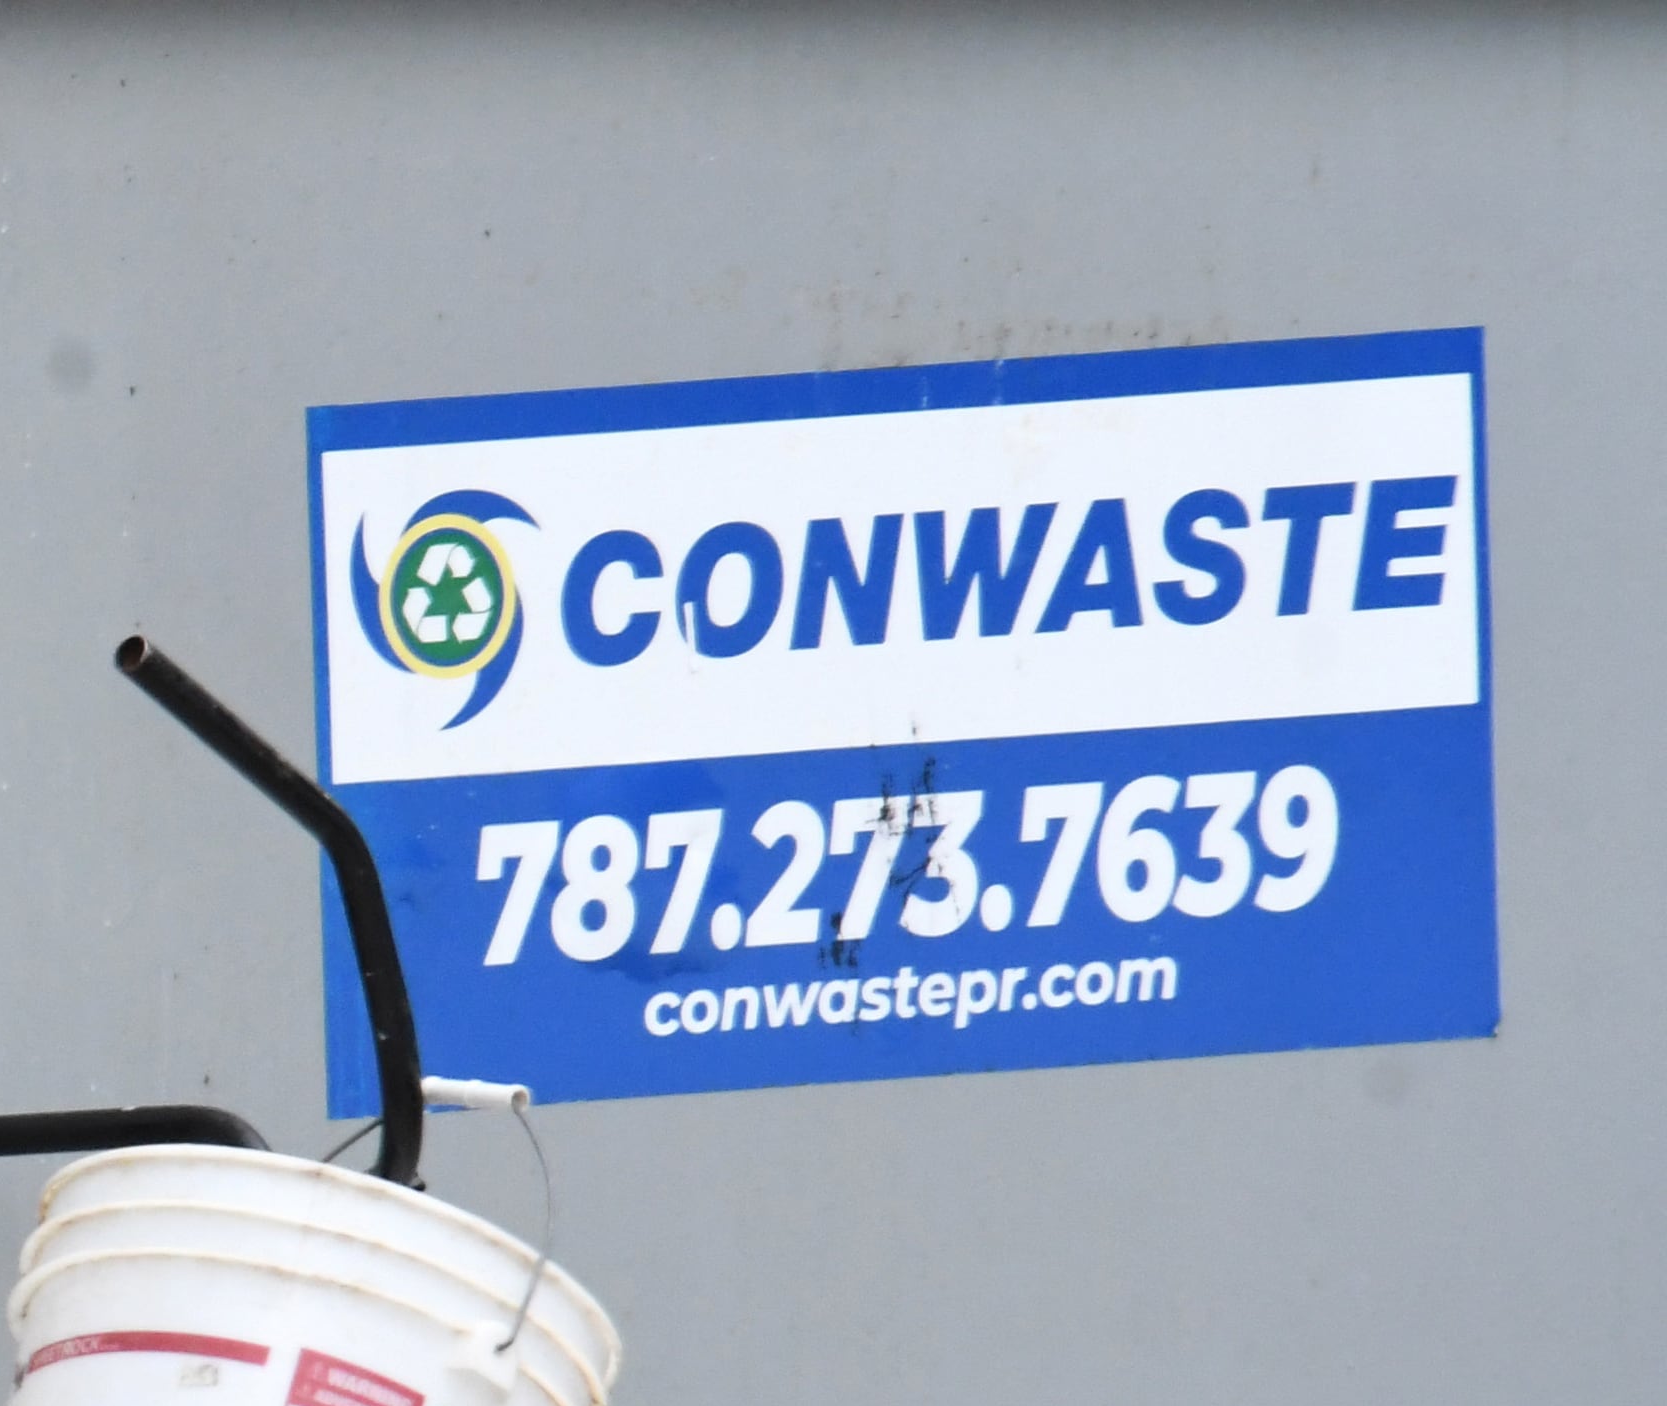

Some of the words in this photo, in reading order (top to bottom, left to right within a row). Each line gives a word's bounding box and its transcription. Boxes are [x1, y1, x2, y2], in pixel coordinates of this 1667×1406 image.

[560, 474, 1458, 667] CONWASTE
[476, 765, 1340, 967] 787.273.7639
[643, 955, 1177, 1037] conwastepr.com
